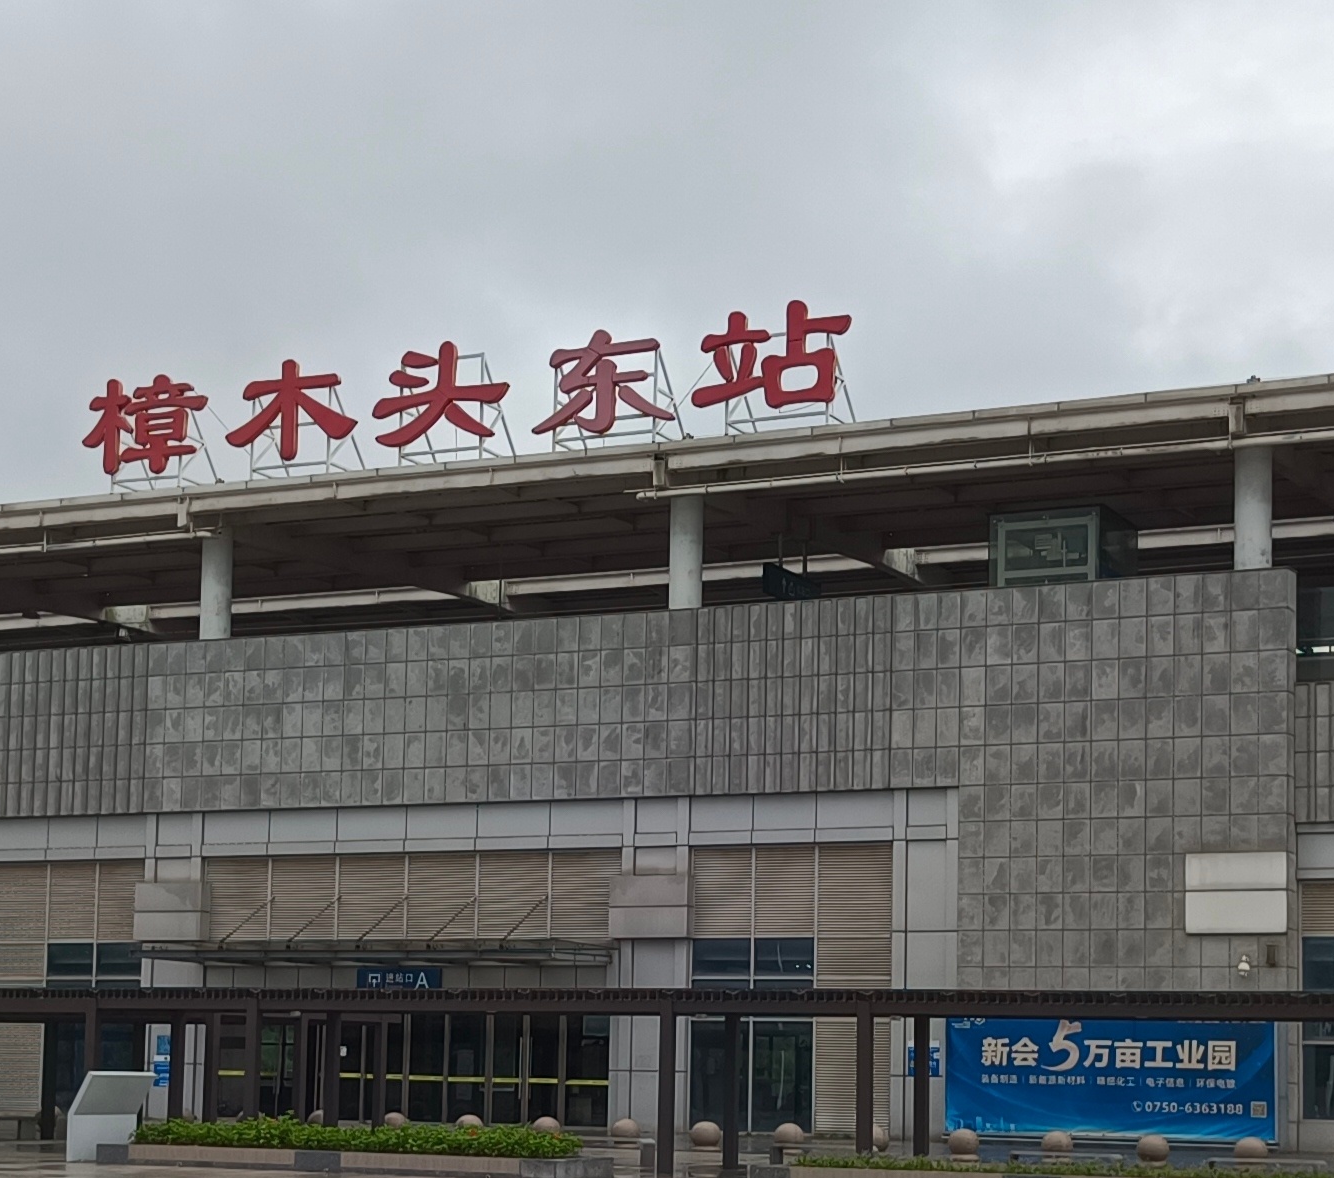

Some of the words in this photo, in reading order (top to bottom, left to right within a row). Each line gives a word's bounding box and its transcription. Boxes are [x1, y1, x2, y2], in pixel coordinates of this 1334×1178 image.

[81, 299, 852, 475] 樟木头东站
[414, 971, 429, 990] A
[981, 1019, 1237, 1072] 新会5万亩工业园
[1145, 1101, 1243, 1115] 0750-6363188
